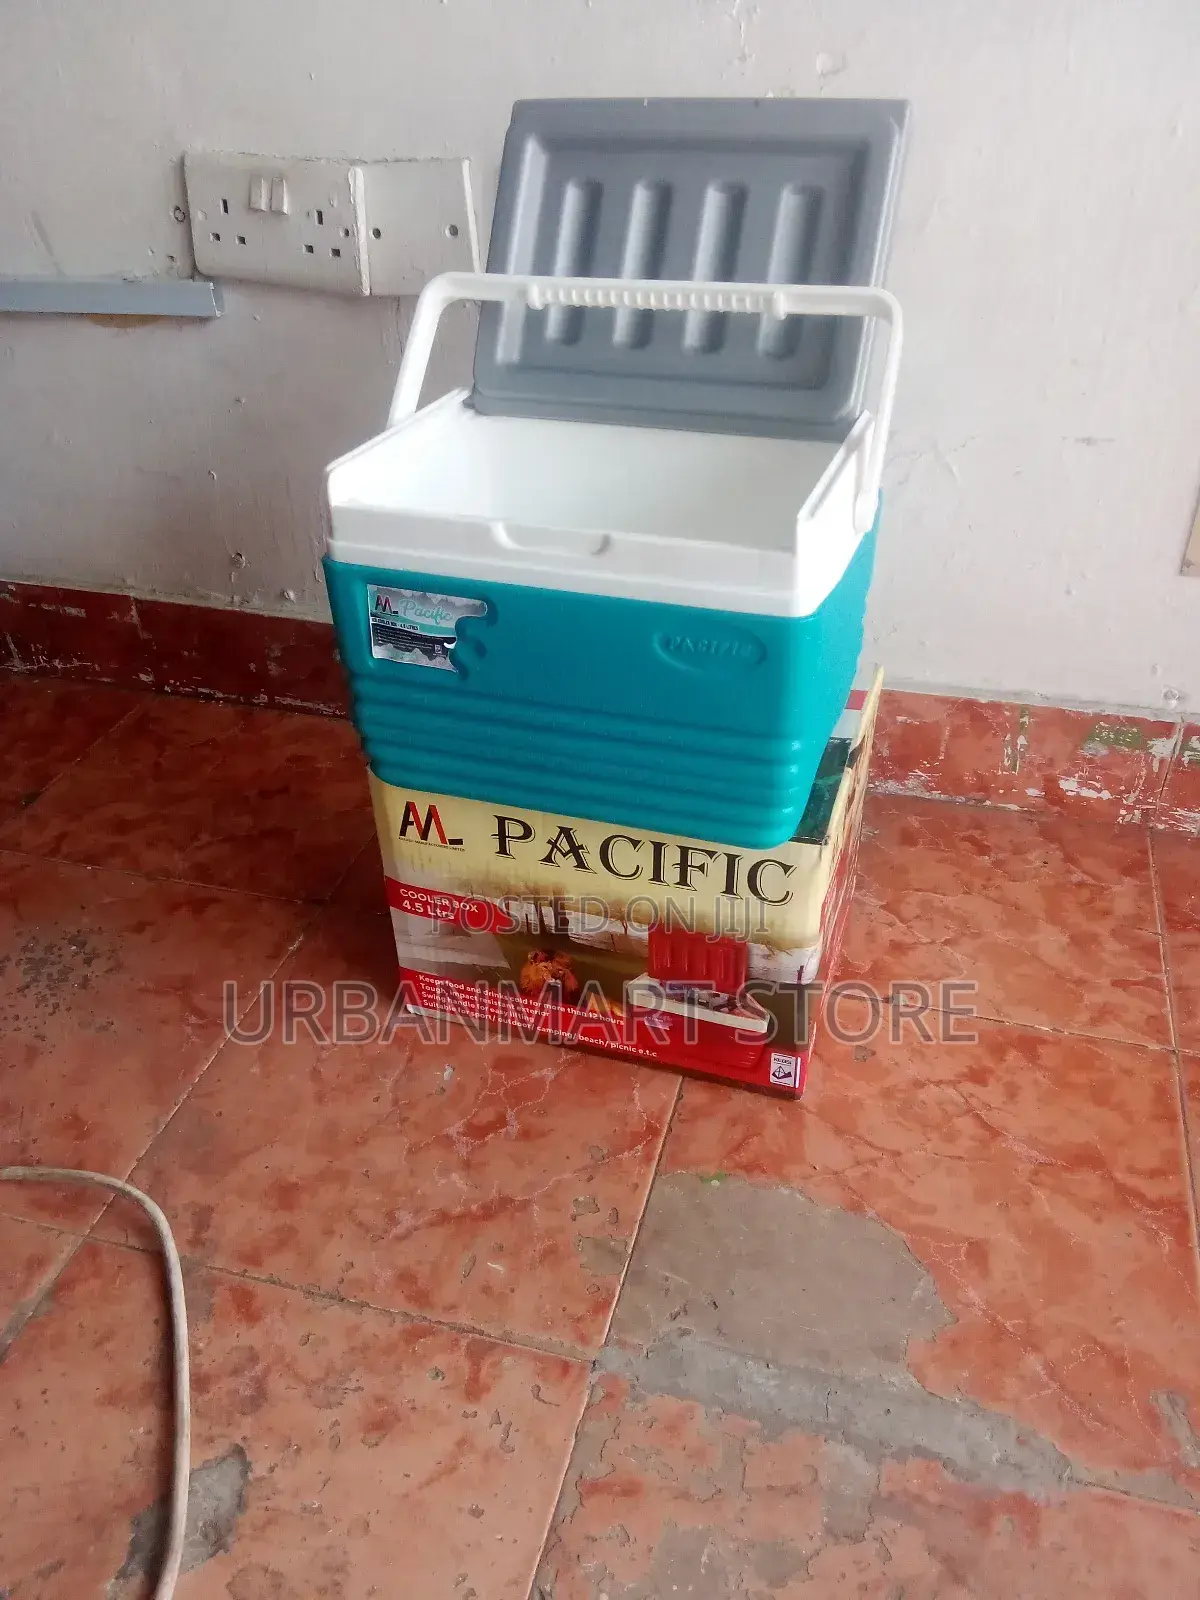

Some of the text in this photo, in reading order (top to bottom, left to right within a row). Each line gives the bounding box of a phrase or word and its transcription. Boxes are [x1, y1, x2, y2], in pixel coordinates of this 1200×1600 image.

[398, 599, 454, 625] Pacific
[491, 814, 799, 907] PACIFIC
[400, 888, 479, 913] COOLER BOX
[402, 900, 455, 920] 4.5 Ltrs
[419, 974, 625, 1026] Keeps food and drinks cold for more than 12 hours
[422, 991, 535, 1023] Swing handle for easy lifting
[449, 989, 478, 1001] impact
[479, 997, 515, 1010] resistant
[516, 1005, 550, 1017] exterior
[423, 1000, 457, 1012] Suitable
[457, 1007, 470, 1016] for
[610, 1041, 637, 1054] picnic
